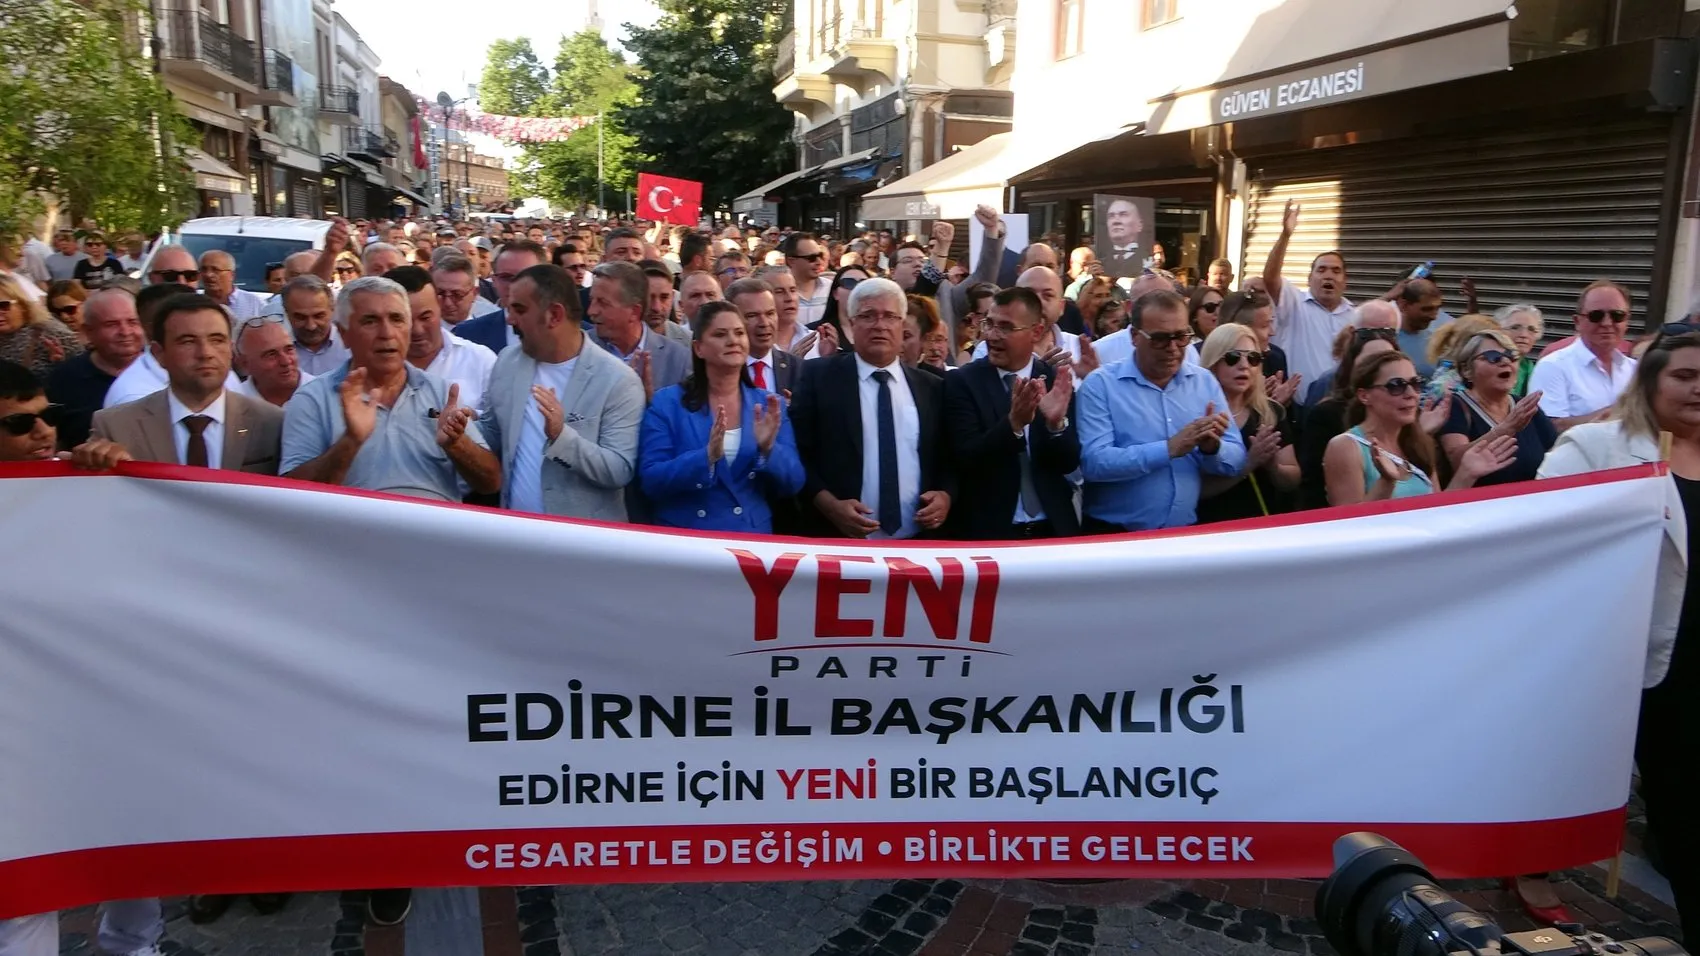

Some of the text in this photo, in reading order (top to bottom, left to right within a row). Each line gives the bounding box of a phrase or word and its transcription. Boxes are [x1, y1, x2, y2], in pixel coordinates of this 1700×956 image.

[1220, 62, 1364, 117] GÜVEN ECZANESİ
[726, 547, 1000, 644] YENİ
[467, 672, 1246, 746] EDİRNE İL BAŞKANLIĞI
[498, 757, 1220, 809] EDİRNE İÇİN YENİ BİR BAŞLANGIÇ
[465, 829, 1254, 870] CESARETLE DEĞİŞİM BİRLİKTE GELECEK
